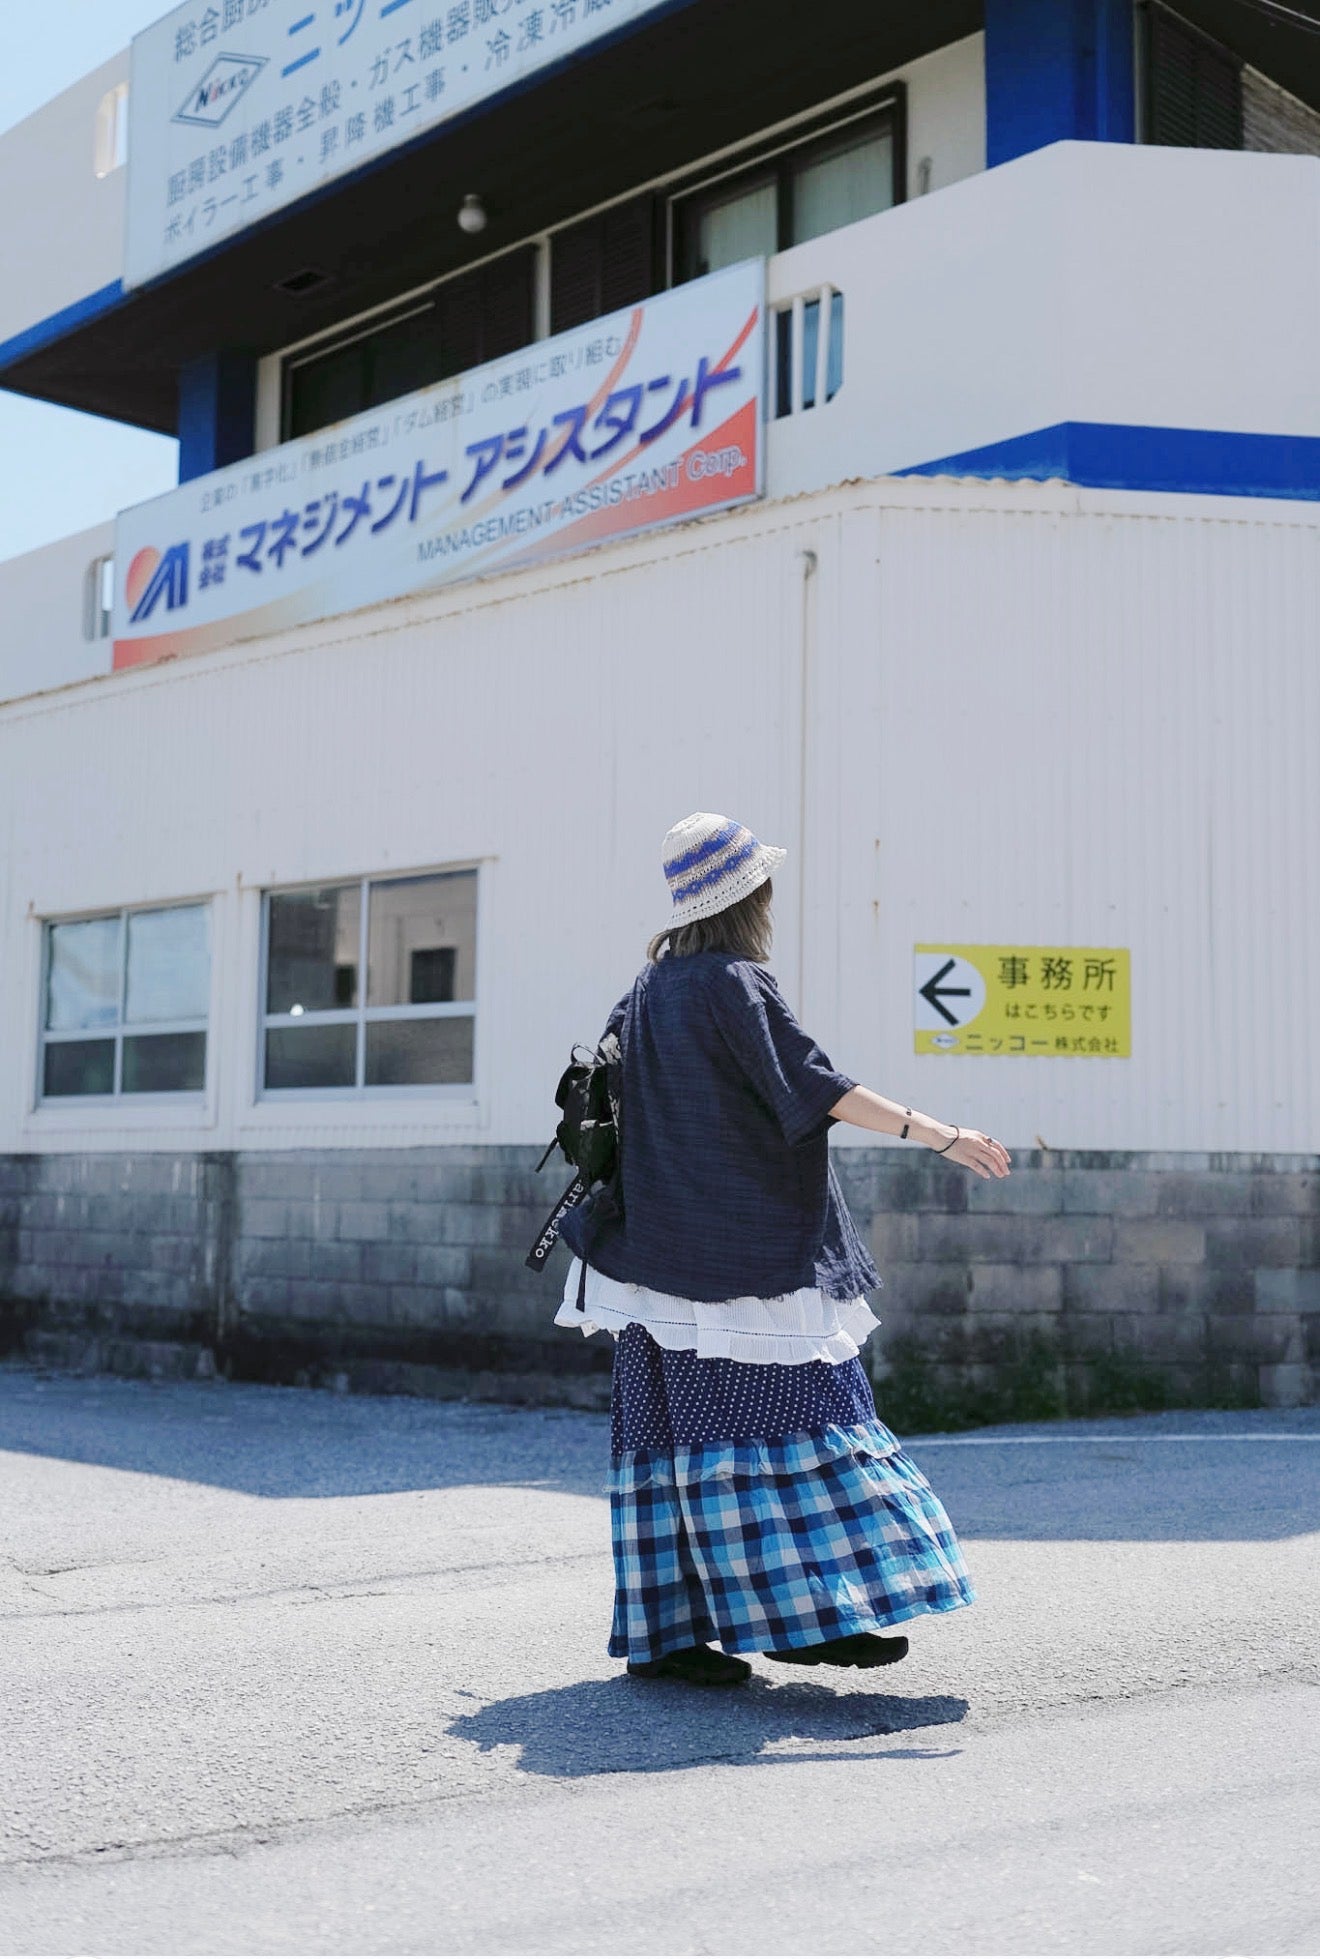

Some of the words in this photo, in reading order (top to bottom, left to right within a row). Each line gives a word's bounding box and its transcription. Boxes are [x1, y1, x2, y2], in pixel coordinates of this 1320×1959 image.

[236, 460, 449, 573] マネジメント
[460, 356, 743, 505] アシスタント
[417, 501, 553, 562] MANAGEMENT
[556, 459, 684, 521] ASSISTANT
[686, 444, 748, 481] Corp.
[998, 955, 1117, 992] 事務所
[1004, 1003, 1112, 1022] はこちらです
[535, 1179, 584, 1258] arimekko
